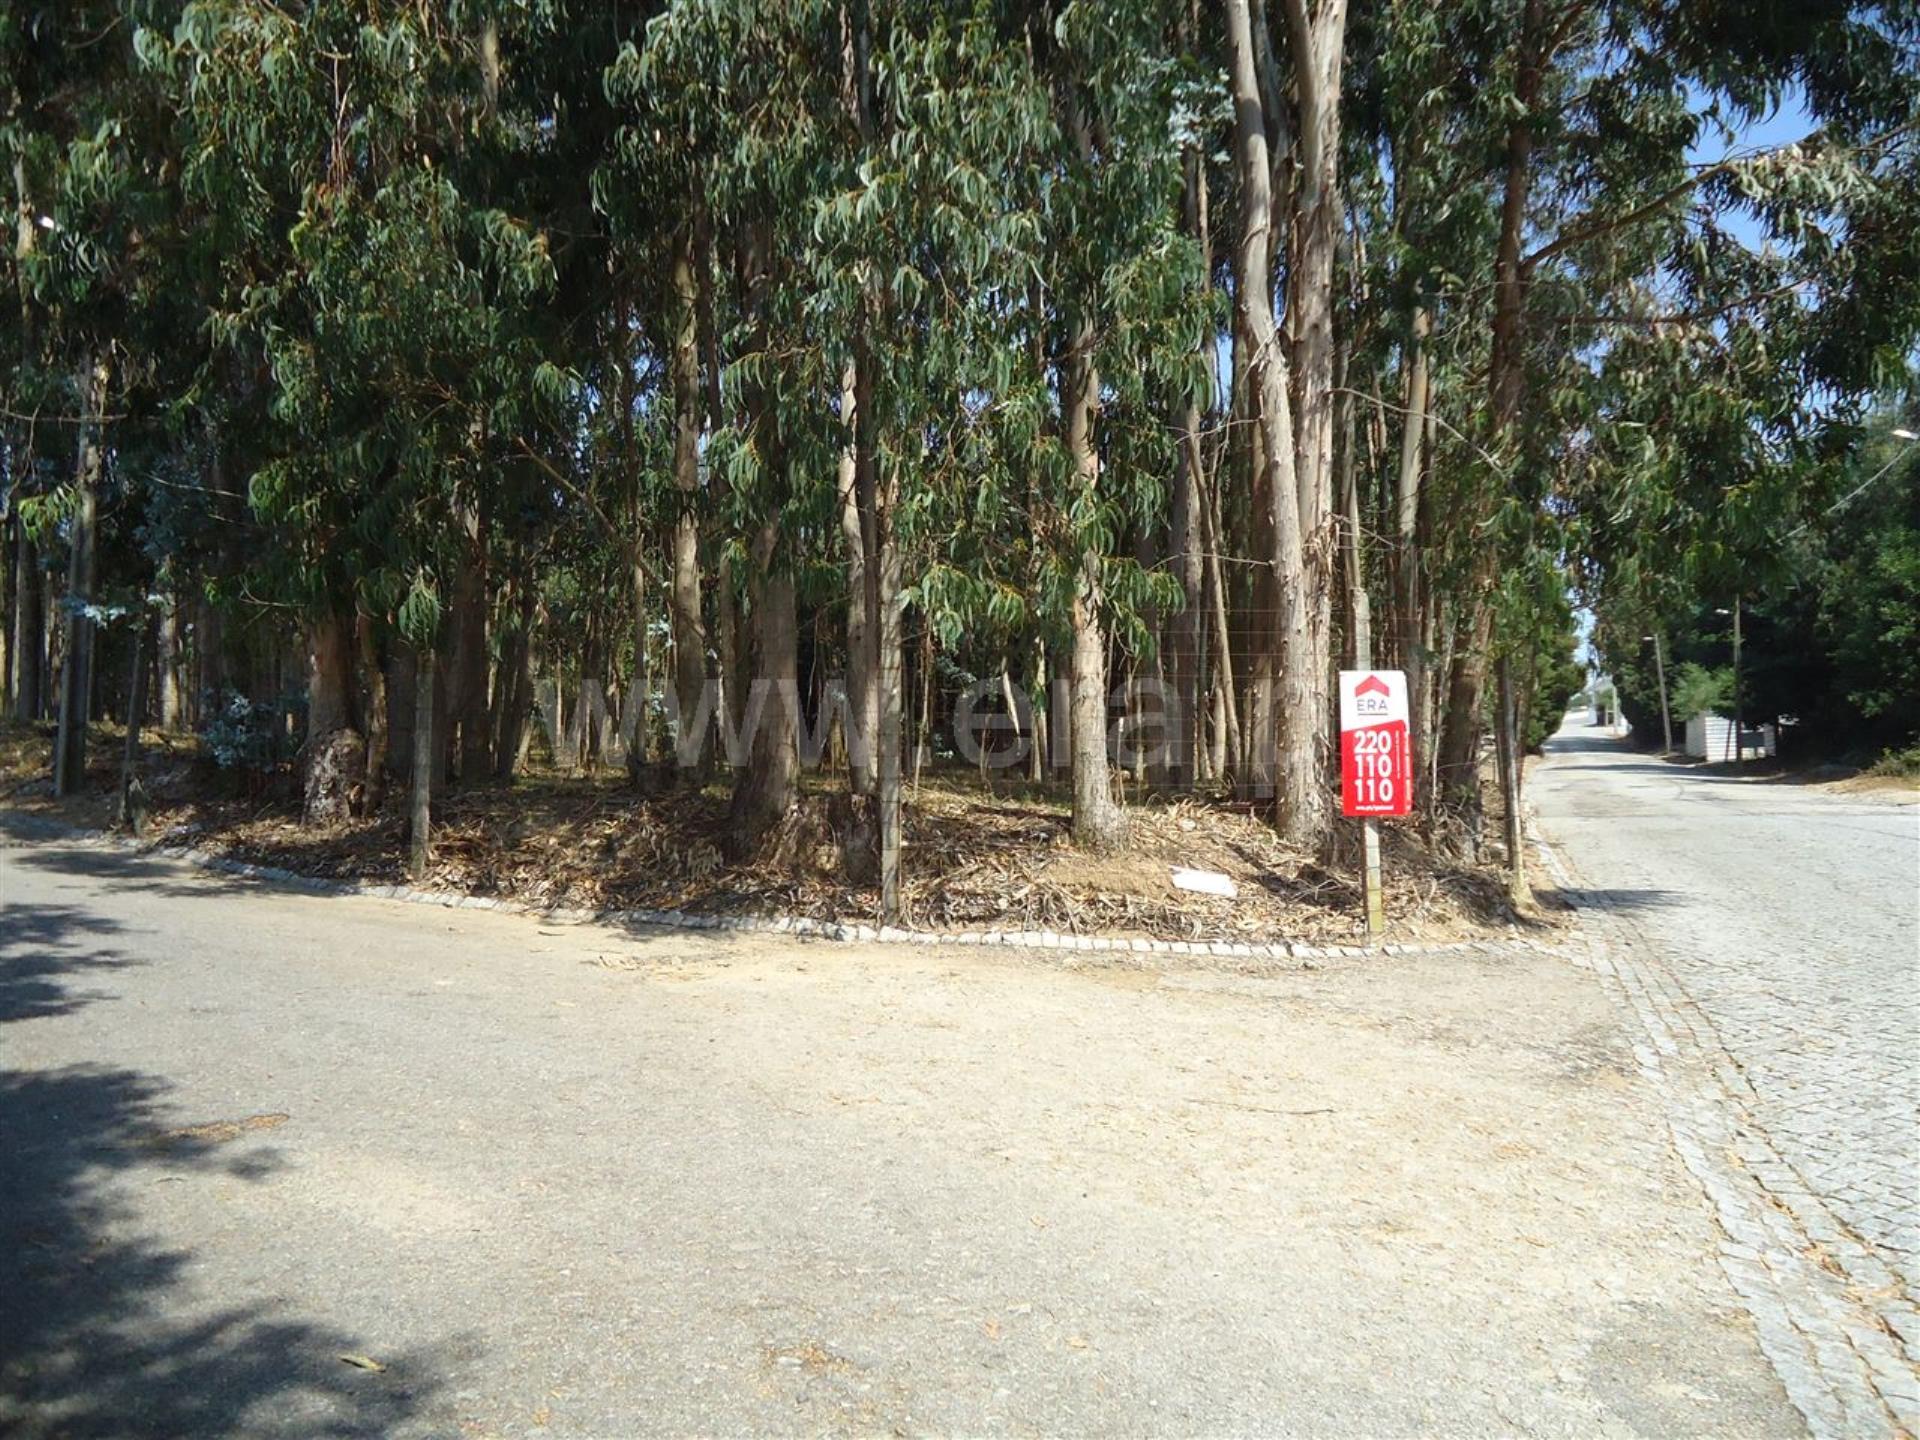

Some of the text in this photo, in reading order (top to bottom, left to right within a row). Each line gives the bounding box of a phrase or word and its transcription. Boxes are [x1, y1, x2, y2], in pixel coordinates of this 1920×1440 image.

[1356, 698, 1388, 711] ERA
[1353, 730, 1392, 753] 220
[1354, 754, 1393, 777] 110
[1354, 778, 1394, 802] 110
